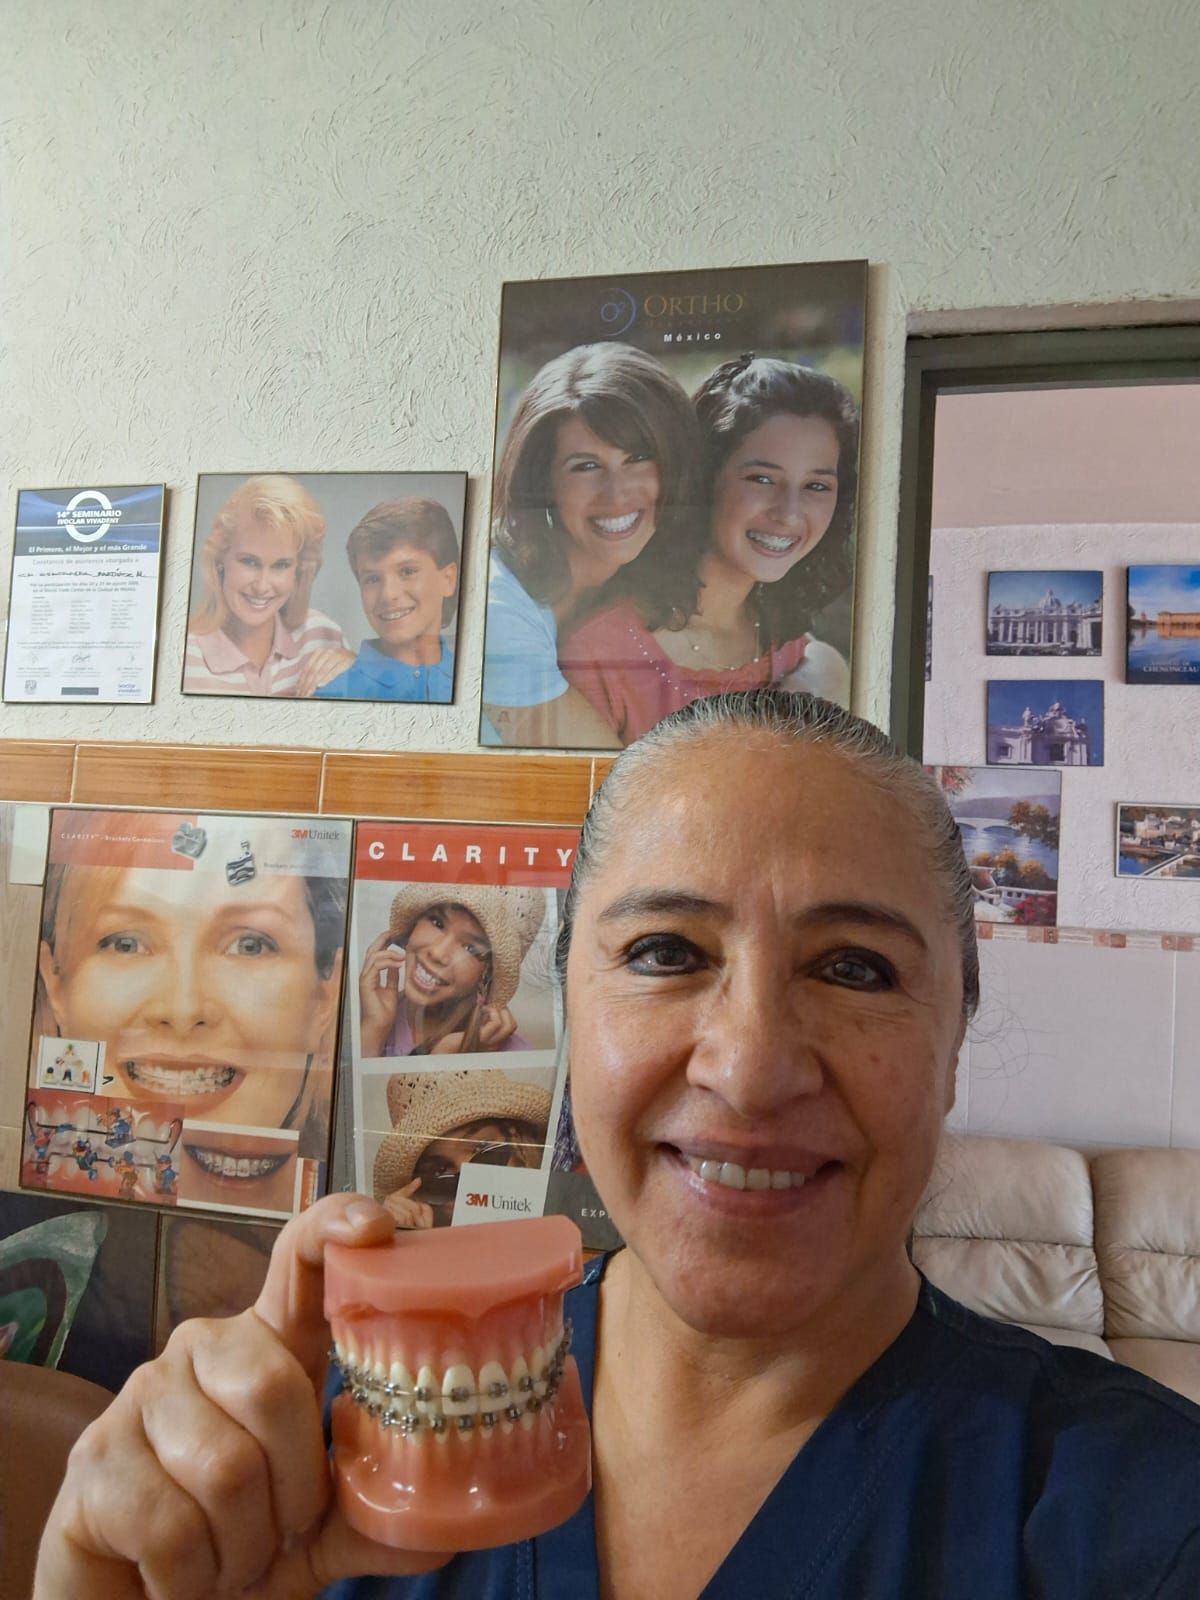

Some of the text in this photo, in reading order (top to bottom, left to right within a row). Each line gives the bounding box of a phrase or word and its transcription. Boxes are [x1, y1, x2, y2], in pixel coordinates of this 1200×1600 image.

[644, 295, 743, 317] ORTHO
[664, 332, 720, 342] México
[72, 510, 121, 518] SEMINARIO
[73, 545, 93, 553] Mejor
[291, 829, 340, 840] 3M Unitek
[369, 842, 573, 867] CLARITY
[466, 1193, 533, 1212] 3M Unitek
